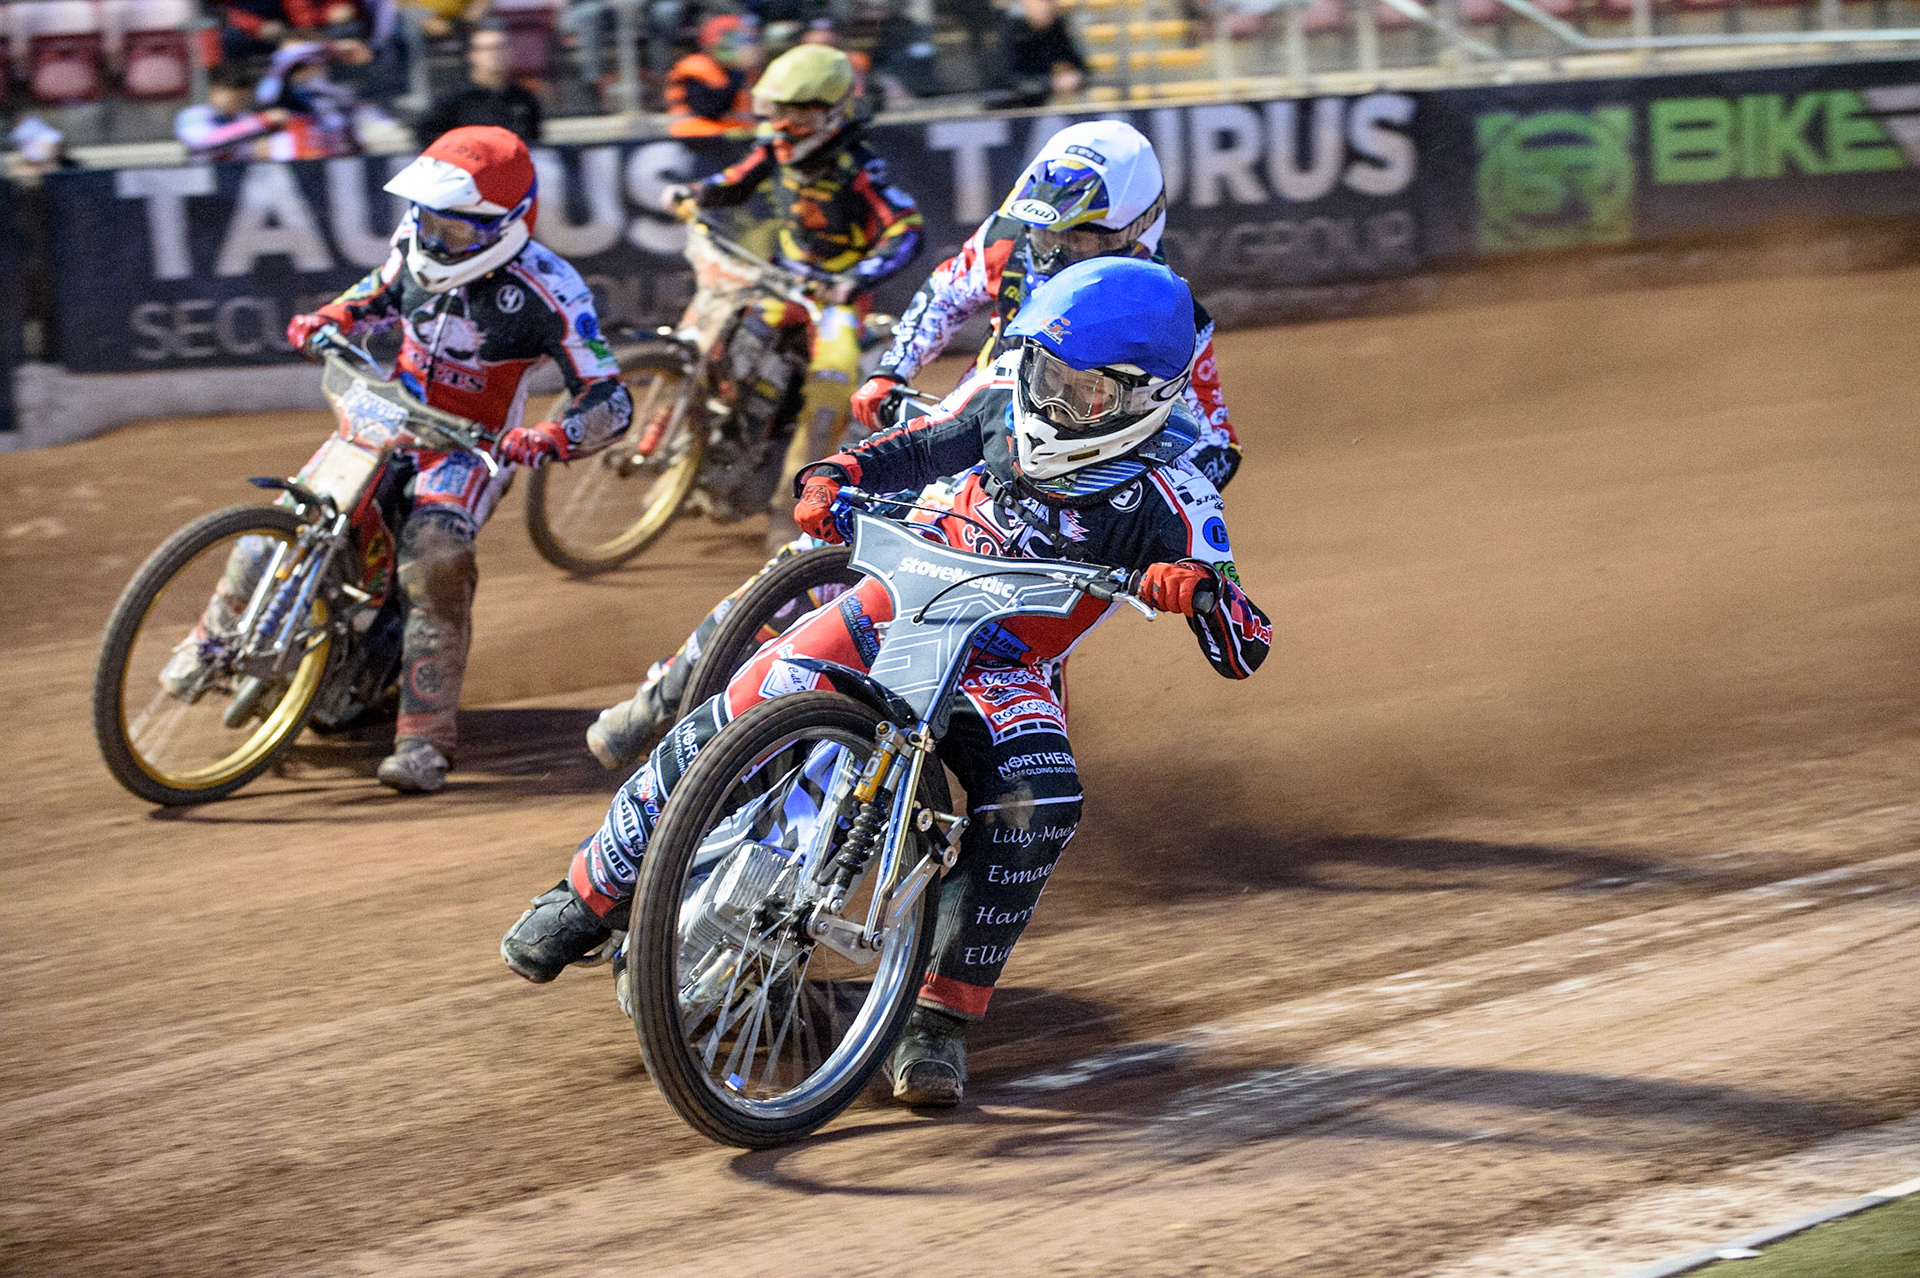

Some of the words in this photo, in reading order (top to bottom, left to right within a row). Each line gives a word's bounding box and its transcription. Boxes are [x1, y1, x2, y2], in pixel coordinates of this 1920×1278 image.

[926, 93, 1417, 226] TURUS
[1648, 89, 1905, 184] BIKE
[116, 141, 697, 280] TAUUS
[992, 825, 1072, 848] Lilly-Mae
